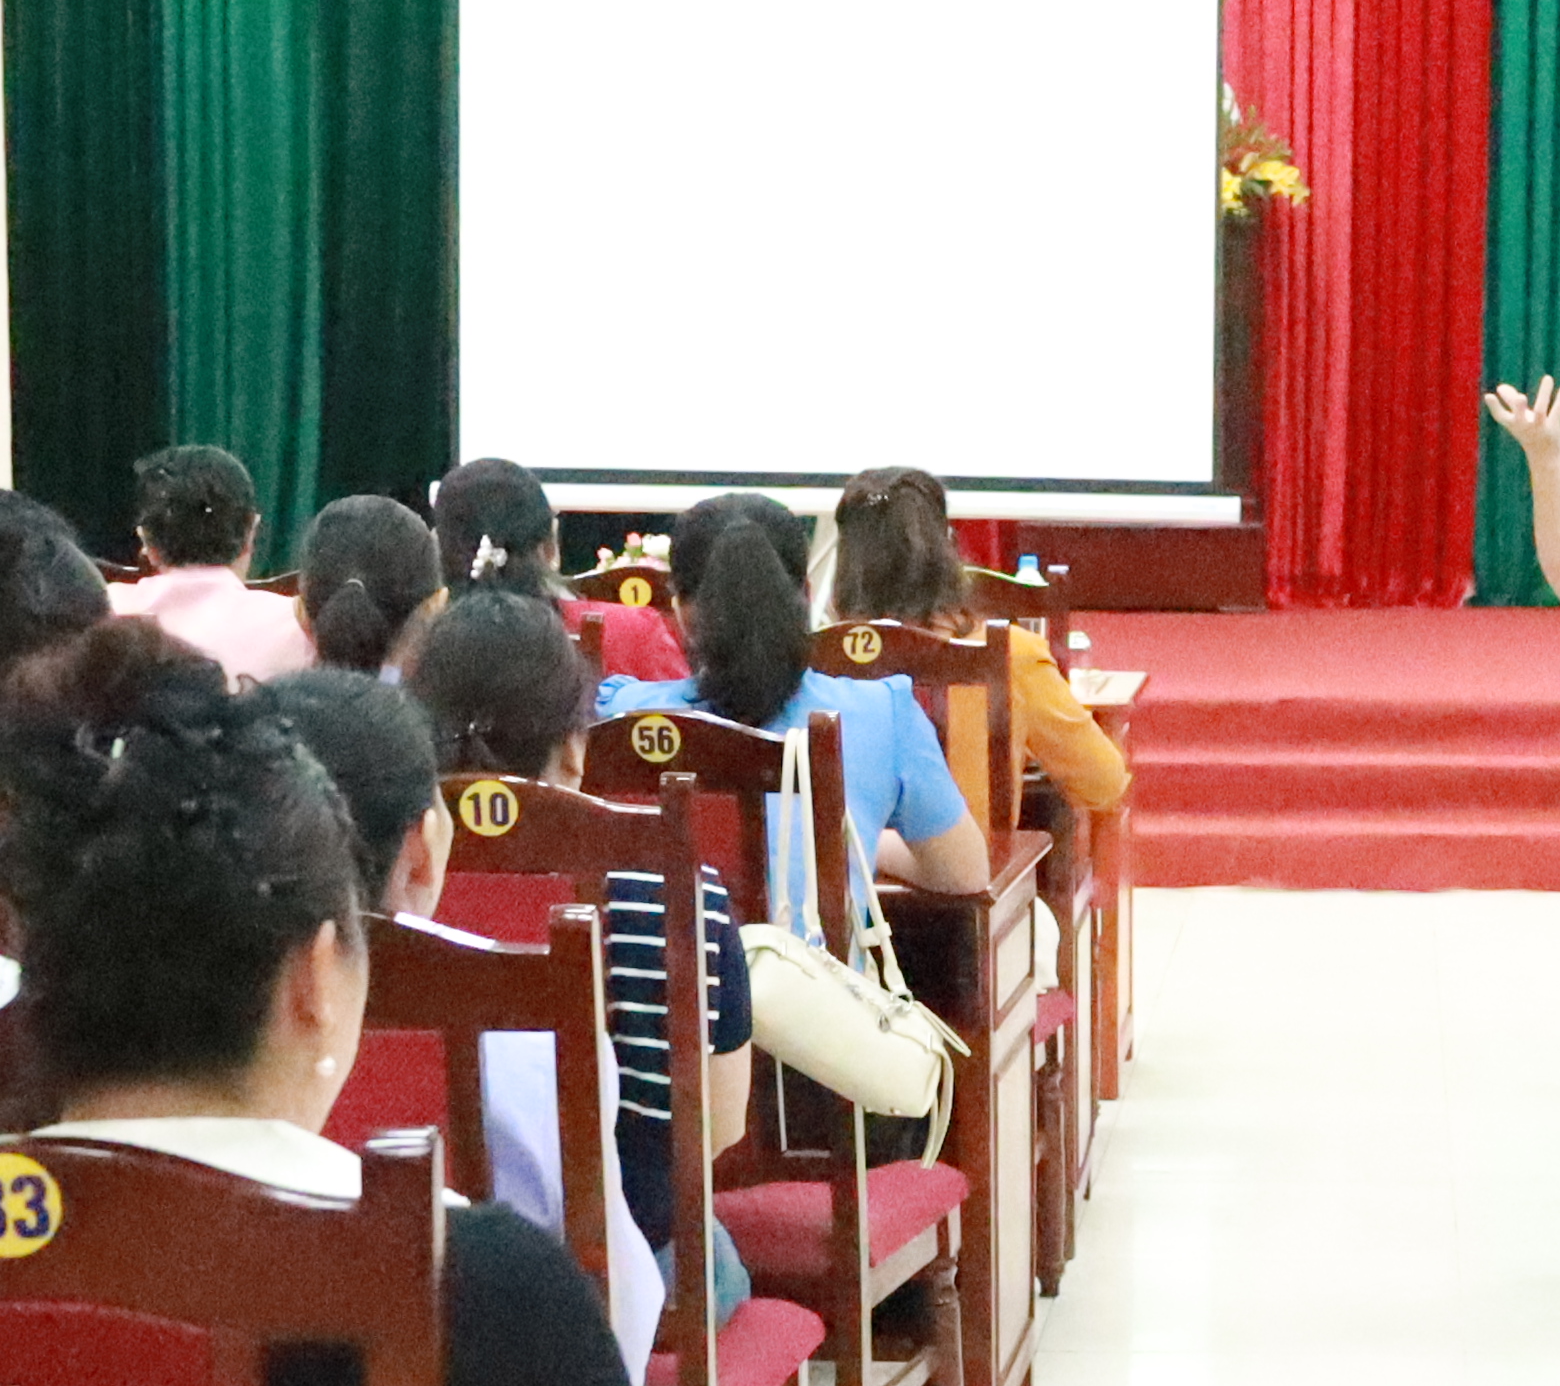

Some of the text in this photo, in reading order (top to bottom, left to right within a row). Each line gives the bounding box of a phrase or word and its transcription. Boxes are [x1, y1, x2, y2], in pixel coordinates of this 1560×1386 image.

[631, 583, 640, 603] 1
[849, 633, 875, 654] 72
[639, 726, 673, 753] 56
[468, 793, 510, 826] 10
